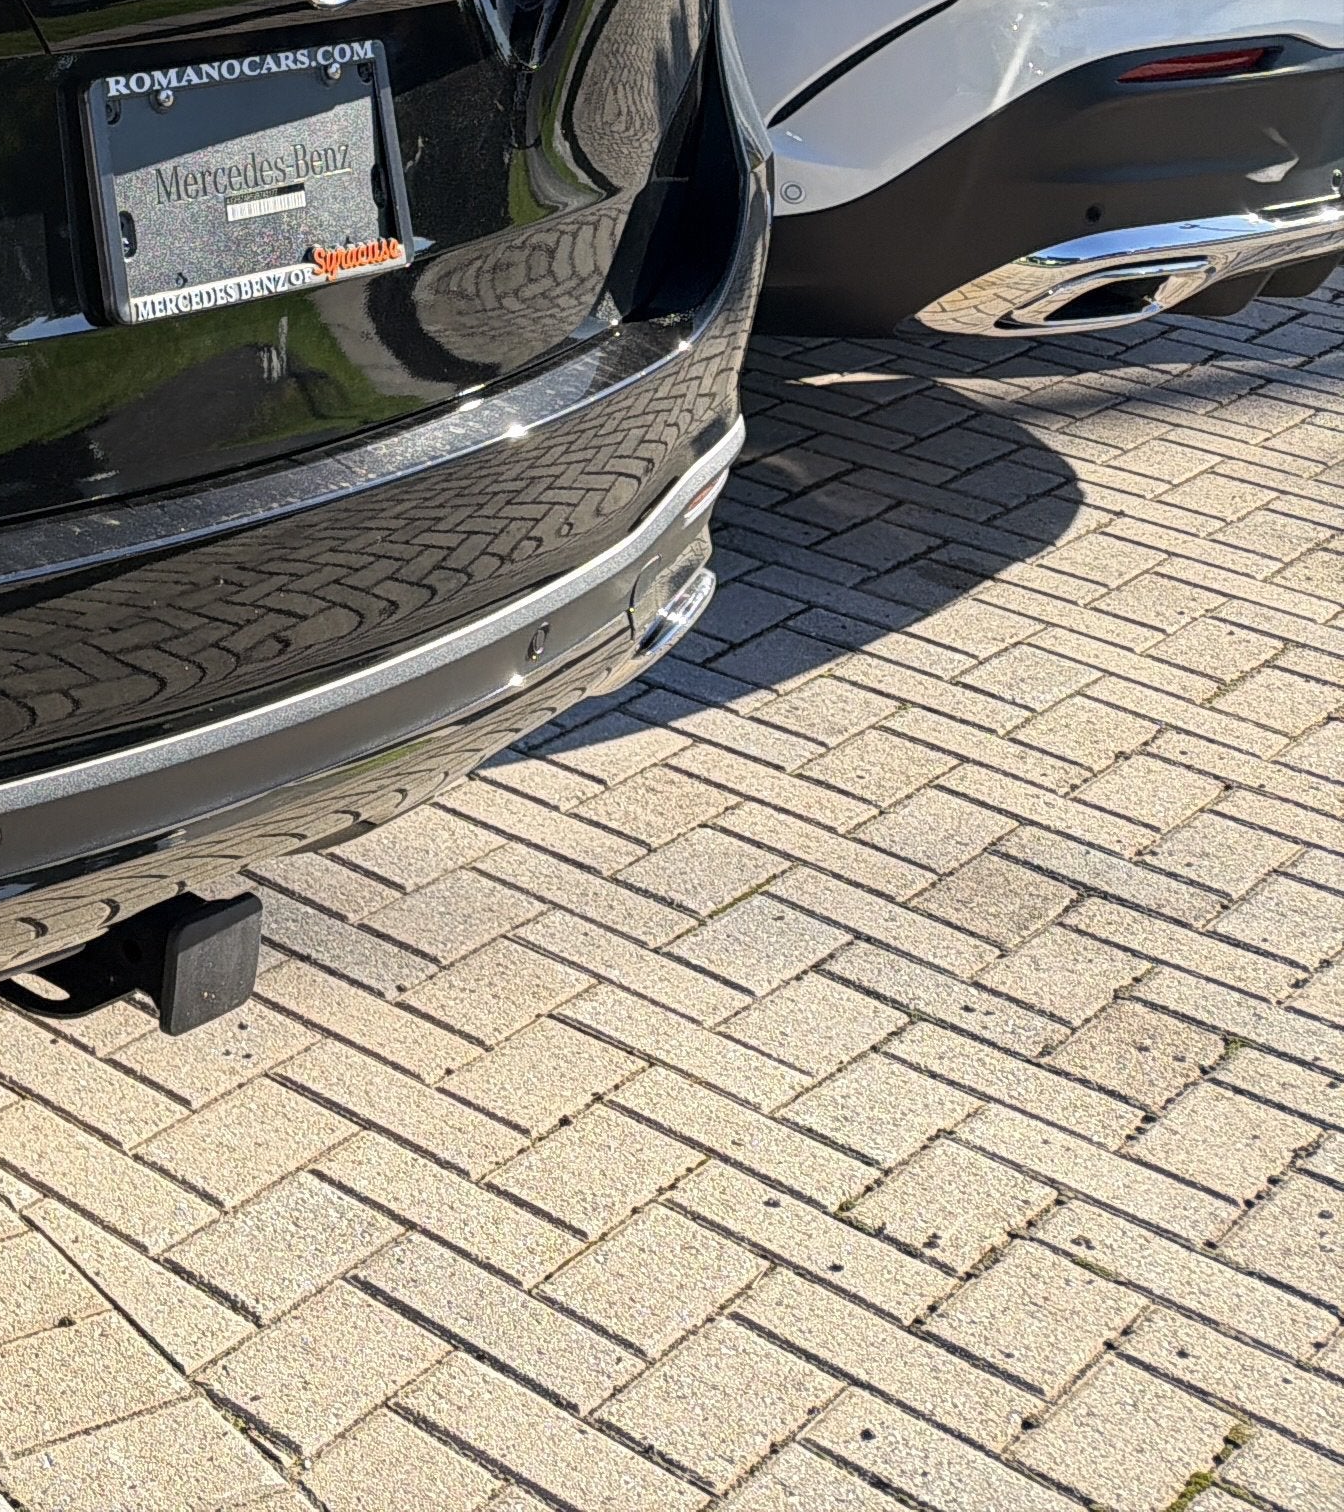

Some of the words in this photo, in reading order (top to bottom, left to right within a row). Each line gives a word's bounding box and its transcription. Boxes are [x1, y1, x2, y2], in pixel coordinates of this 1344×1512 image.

[106, 40, 374, 96] ROMANOCARS.COM
[154, 144, 351, 204] Mercedes-Benz
[137, 284, 238, 322] MERCEDES
[240, 272, 289, 302] BENZ
[313, 238, 400, 281] Syracuse
